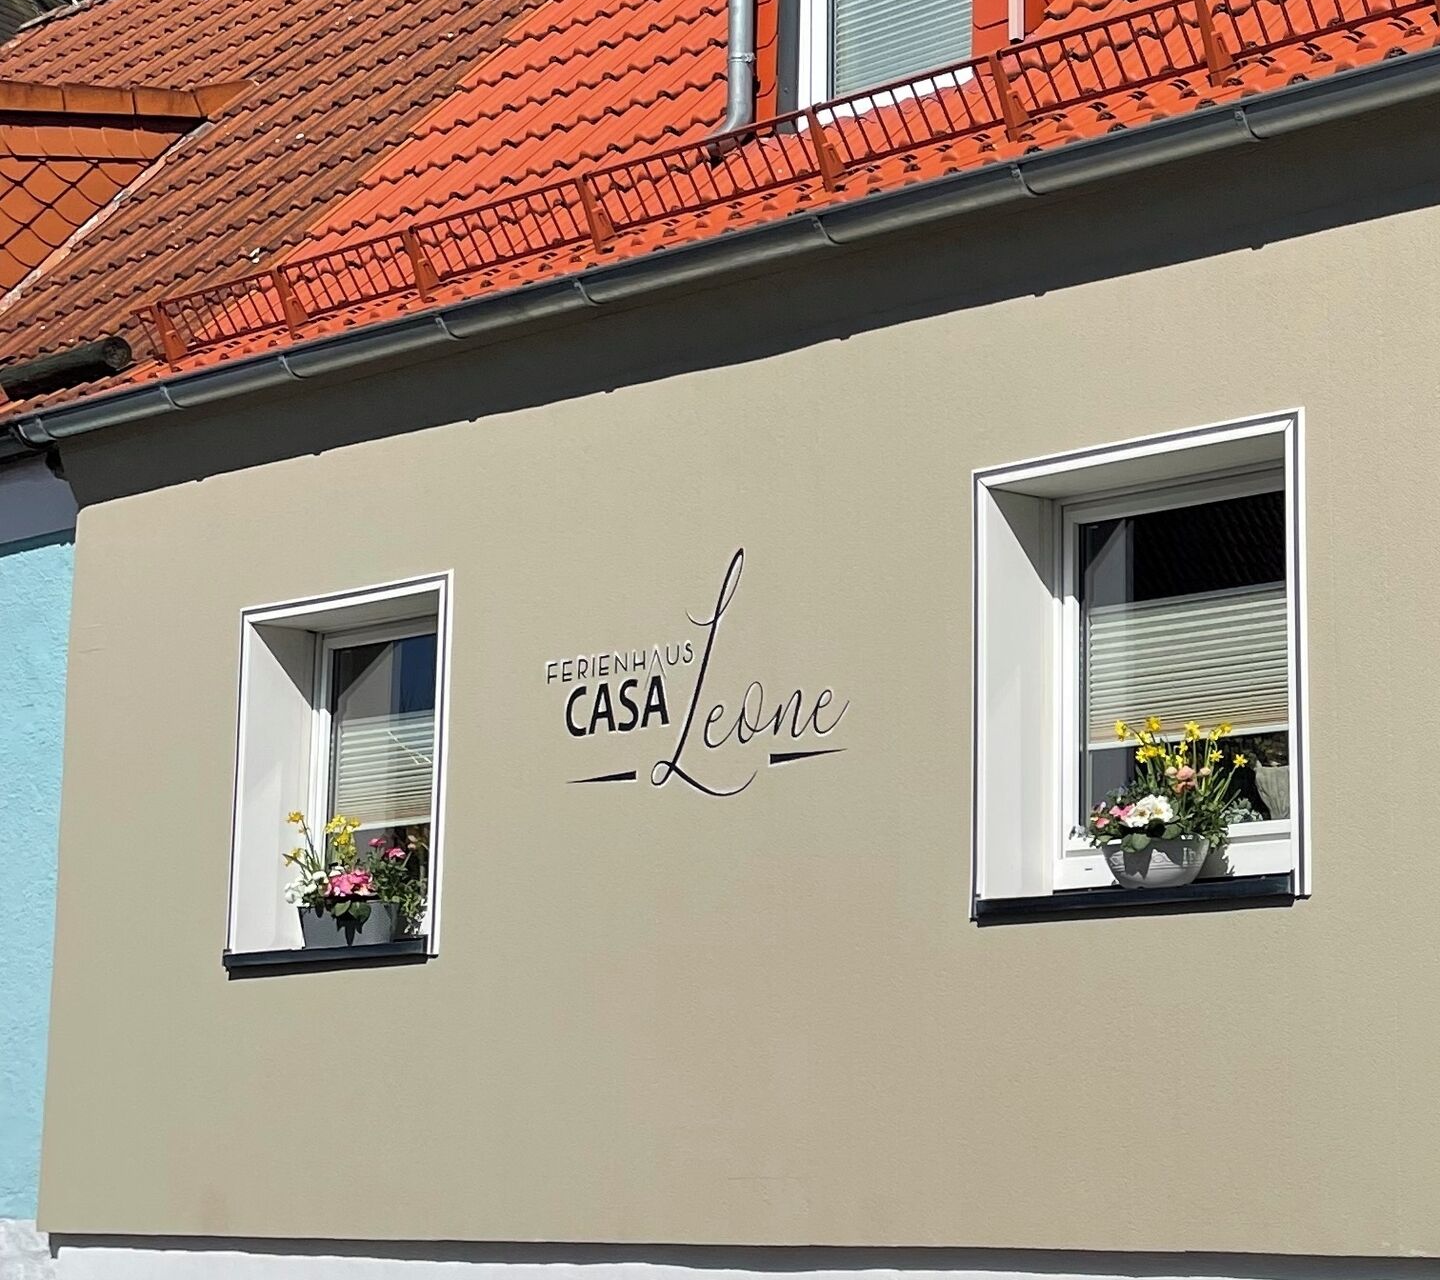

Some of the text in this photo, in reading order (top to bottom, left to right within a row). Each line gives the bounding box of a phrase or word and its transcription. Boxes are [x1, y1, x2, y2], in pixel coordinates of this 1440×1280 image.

[547, 641, 694, 686] FERIENHAUS
[565, 547, 850, 796] CASA Leone
